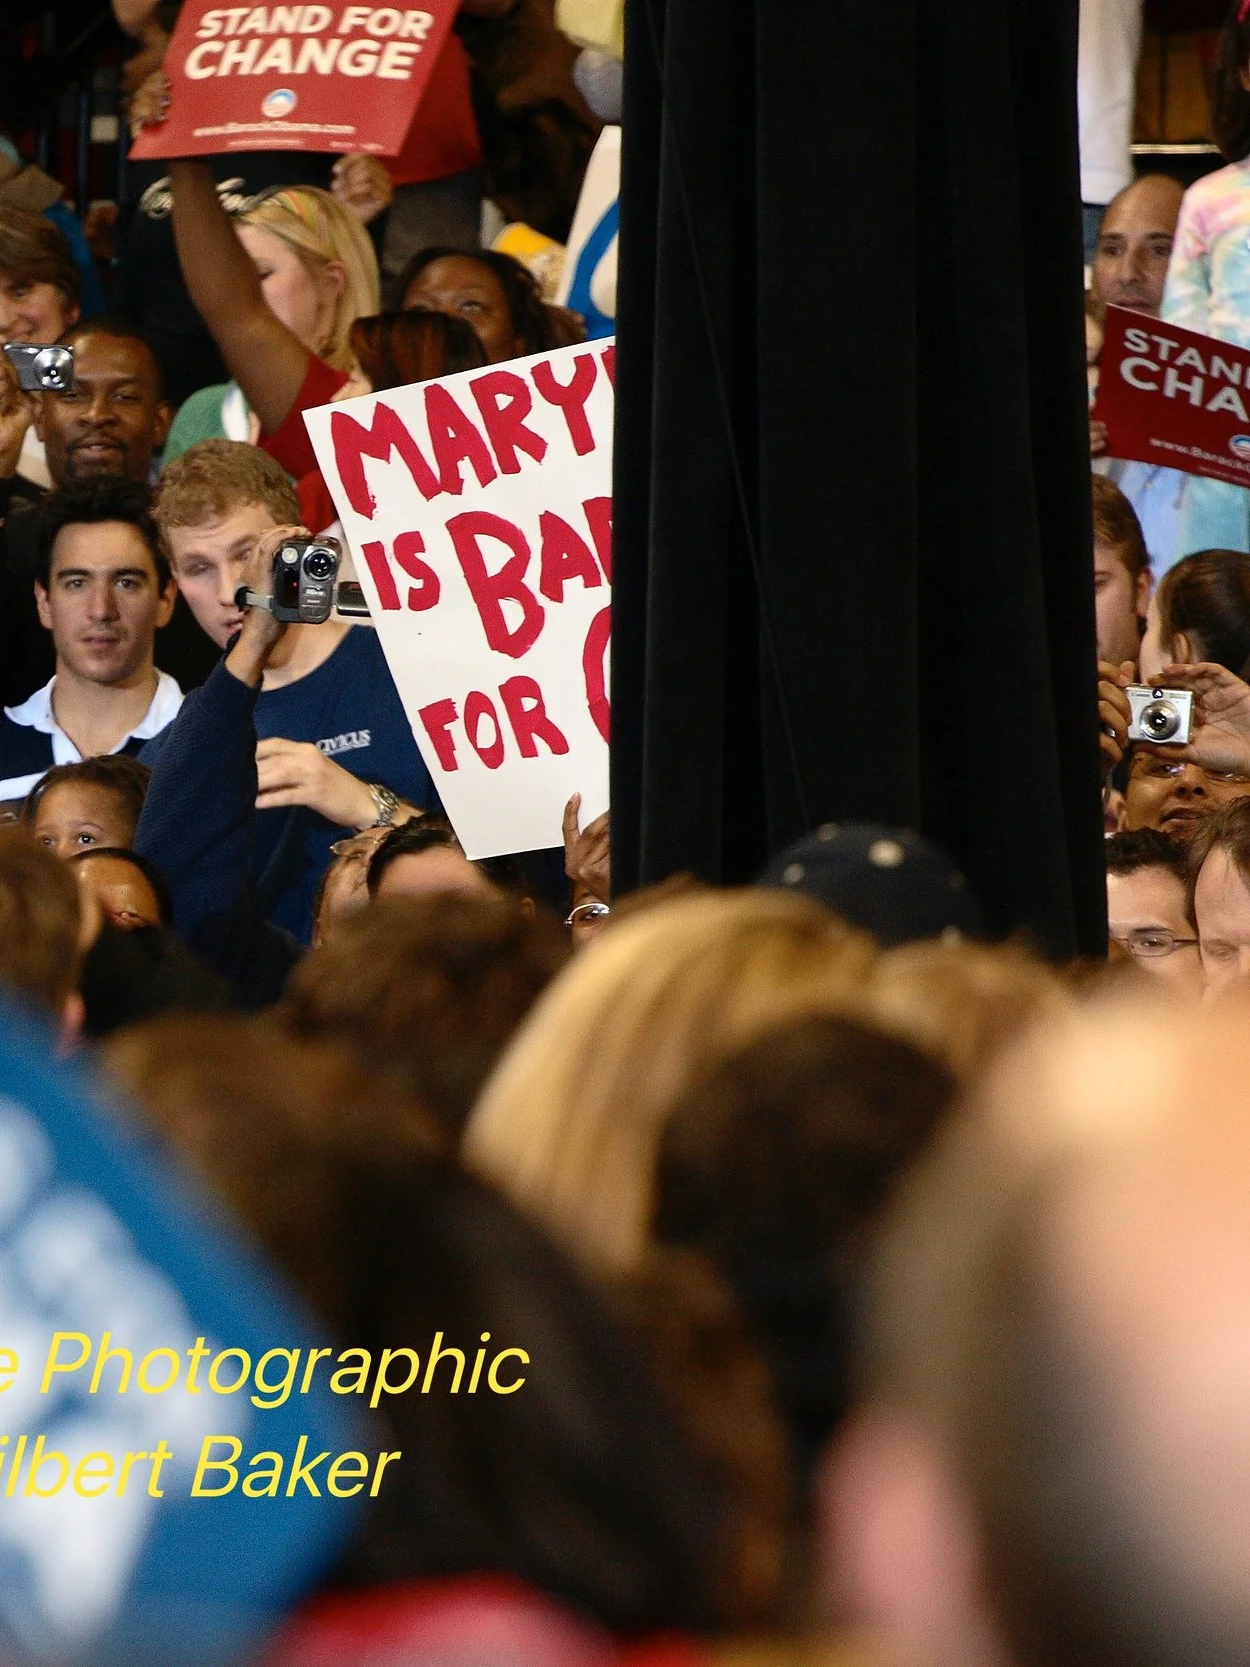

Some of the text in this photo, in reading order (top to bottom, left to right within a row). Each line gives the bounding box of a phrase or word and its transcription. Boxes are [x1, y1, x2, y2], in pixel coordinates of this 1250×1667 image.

[195, 5, 435, 39] STAND FOR
[184, 37, 422, 80] CHANGE
[1123, 327, 1250, 390] STAN
[361, 530, 441, 611] IS
[417, 675, 570, 772] FOR
